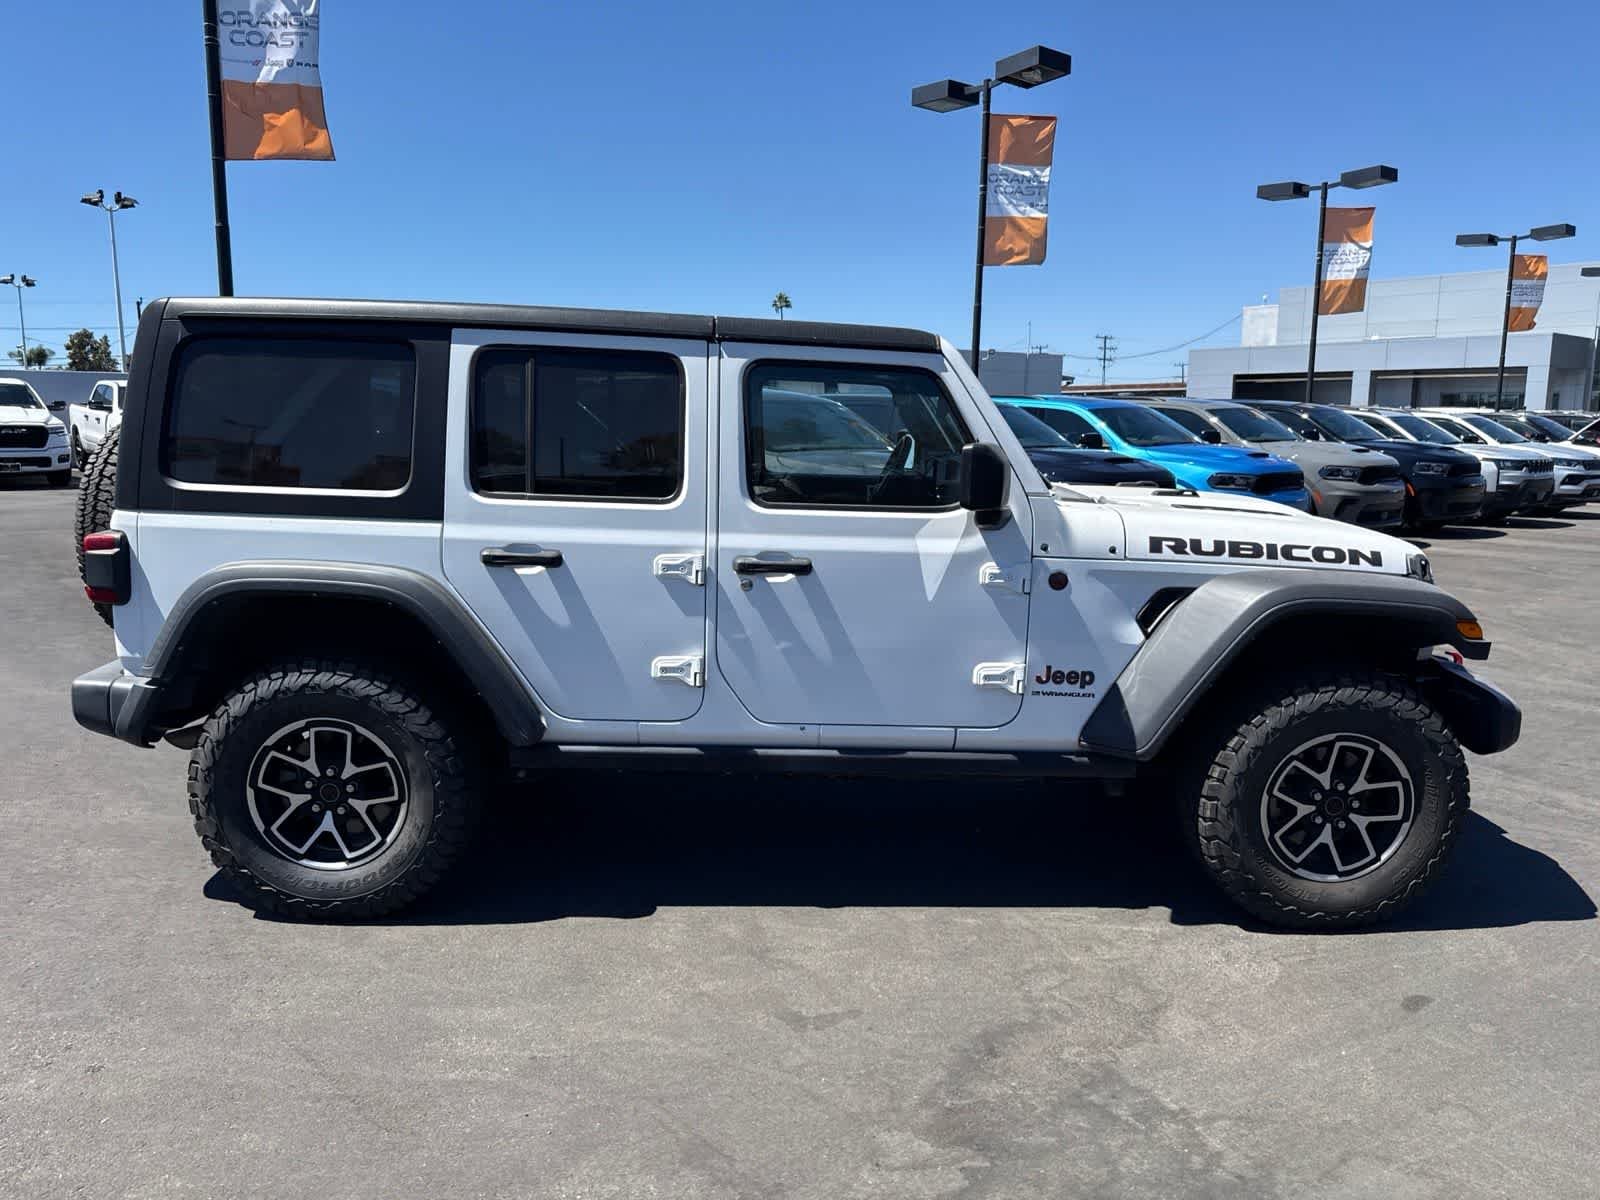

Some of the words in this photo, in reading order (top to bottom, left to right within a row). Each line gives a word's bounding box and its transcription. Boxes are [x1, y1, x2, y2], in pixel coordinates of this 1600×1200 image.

[229, 30, 309, 48] COAST
[1149, 536, 1383, 567] RUBICON
[1035, 664, 1096, 689] Jeep
[1041, 690, 1096, 698] WRANGLER
